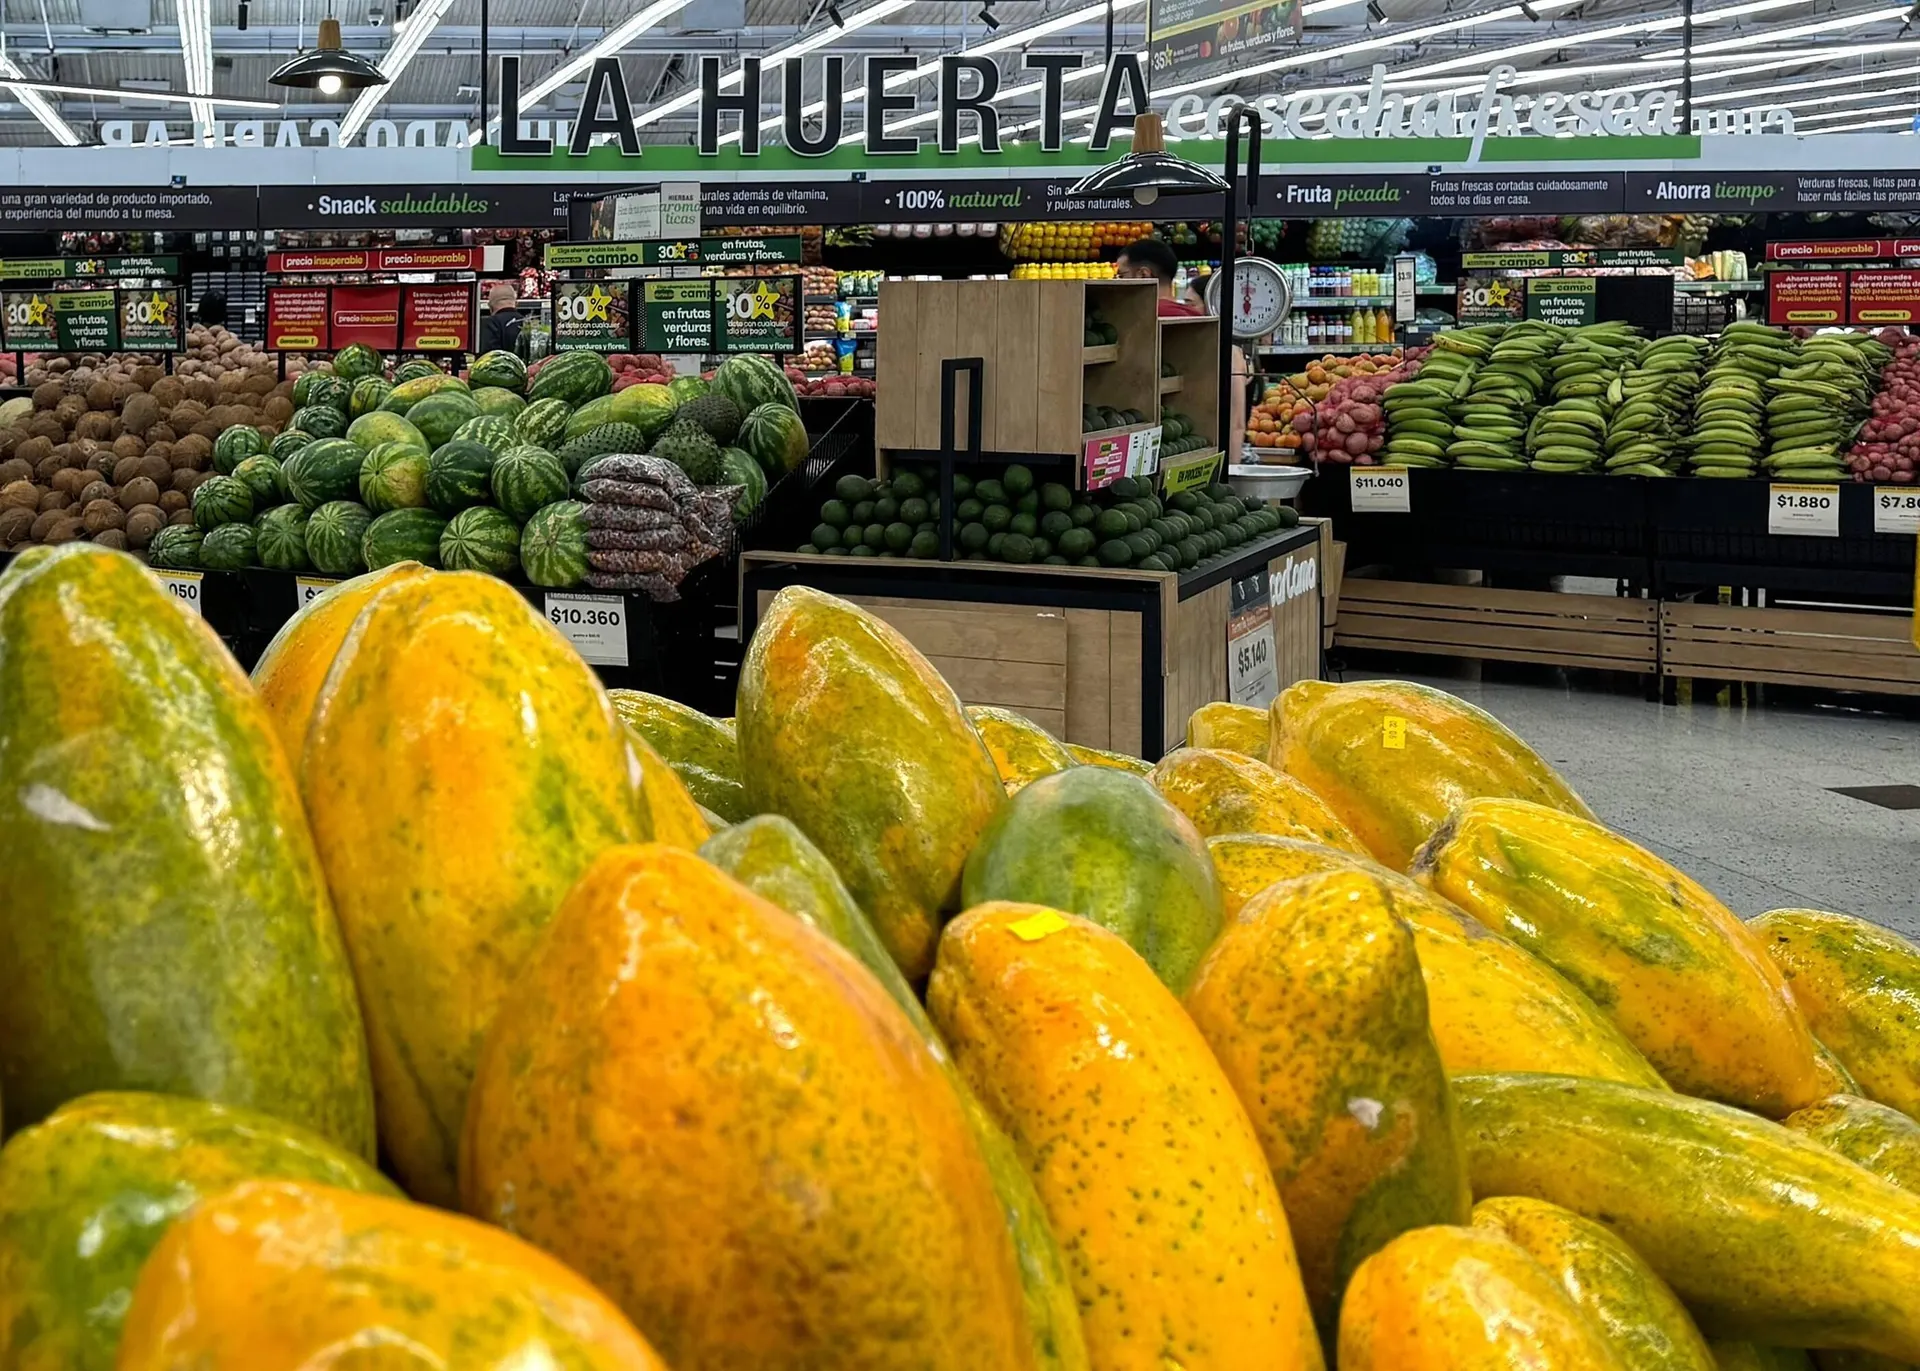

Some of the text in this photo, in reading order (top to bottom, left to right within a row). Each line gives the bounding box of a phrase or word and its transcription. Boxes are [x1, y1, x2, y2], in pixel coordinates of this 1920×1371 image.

[1220, 44, 1227, 55] en
[1246, 32, 1271, 48] verduras
[499, 52, 1150, 157] LA HUERTA
[1166, 63, 1680, 169] cosecha fresca
[1430, 179, 1608, 192] Frutas frescas cortadas cuidadosamente
[1797, 177, 1916, 190] Verduras frescas, listas para
[733, 189, 829, 202] además de vitamina,
[1047, 184, 1062, 196] Sin
[1287, 182, 1400, 210] Fruta picada
[1656, 182, 1775, 206] Ahorra tiempo
[1798, 191, 1821, 202] hacer
[1824, 191, 1841, 202] más
[1843, 190, 1871, 202] fáciles
[1873, 190, 1886, 201] tus
[2, 192, 213, 207] una gran variedad de producto importado,
[553, 191, 570, 203] Las
[895, 187, 1022, 209] 100% natural
[1430, 193, 1531, 205] todos los días en casa.
[318, 192, 488, 215] Snack saludables
[706, 203, 808, 216] una vida en equilibrio.
[1046, 198, 1133, 212] y pulpas naturales.
[5, 207, 175, 221] experiencia del mundo a tu mesa.
[665, 212, 696, 225] ticas
[722, 239, 767, 250] en frutas,
[1781, 244, 1873, 256] precio insuperable
[385, 252, 466, 266] precio insuperable
[587, 253, 639, 265] campo
[704, 249, 785, 263] verduras y flores.
[1628, 250, 1655, 258] frutas,
[121, 257, 153, 267] en frutas,
[286, 255, 363, 267] precio insuperable
[1499, 257, 1545, 268] campo
[1602, 256, 1671, 267] verduras y flores.
[24, 266, 62, 278] campo
[109, 265, 166, 277] verduras y flores.
[1810, 275, 1838, 283] puedes
[1556, 283, 1593, 291] campo
[79, 299, 114, 309] campo
[1540, 297, 1585, 306] en frutas,
[662, 308, 675, 319] en
[1541, 308, 1585, 316] verduras
[67, 315, 108, 326] en frutas,
[339, 313, 395, 324] precio insuperable
[1552, 316, 1581, 325] flores.
[70, 327, 107, 336] verduras
[664, 323, 712, 333] verduras
[74, 336, 107, 348] y flores.
[575, 342, 602, 350] verduras
[667, 335, 710, 348] y flores.
[739, 342, 768, 350] verduras
[1355, 477, 1403, 489] $11.040
[1777, 494, 1830, 508] $1.880
[551, 606, 620, 626] $10.360
[1238, 638, 1267, 677] $5.140
